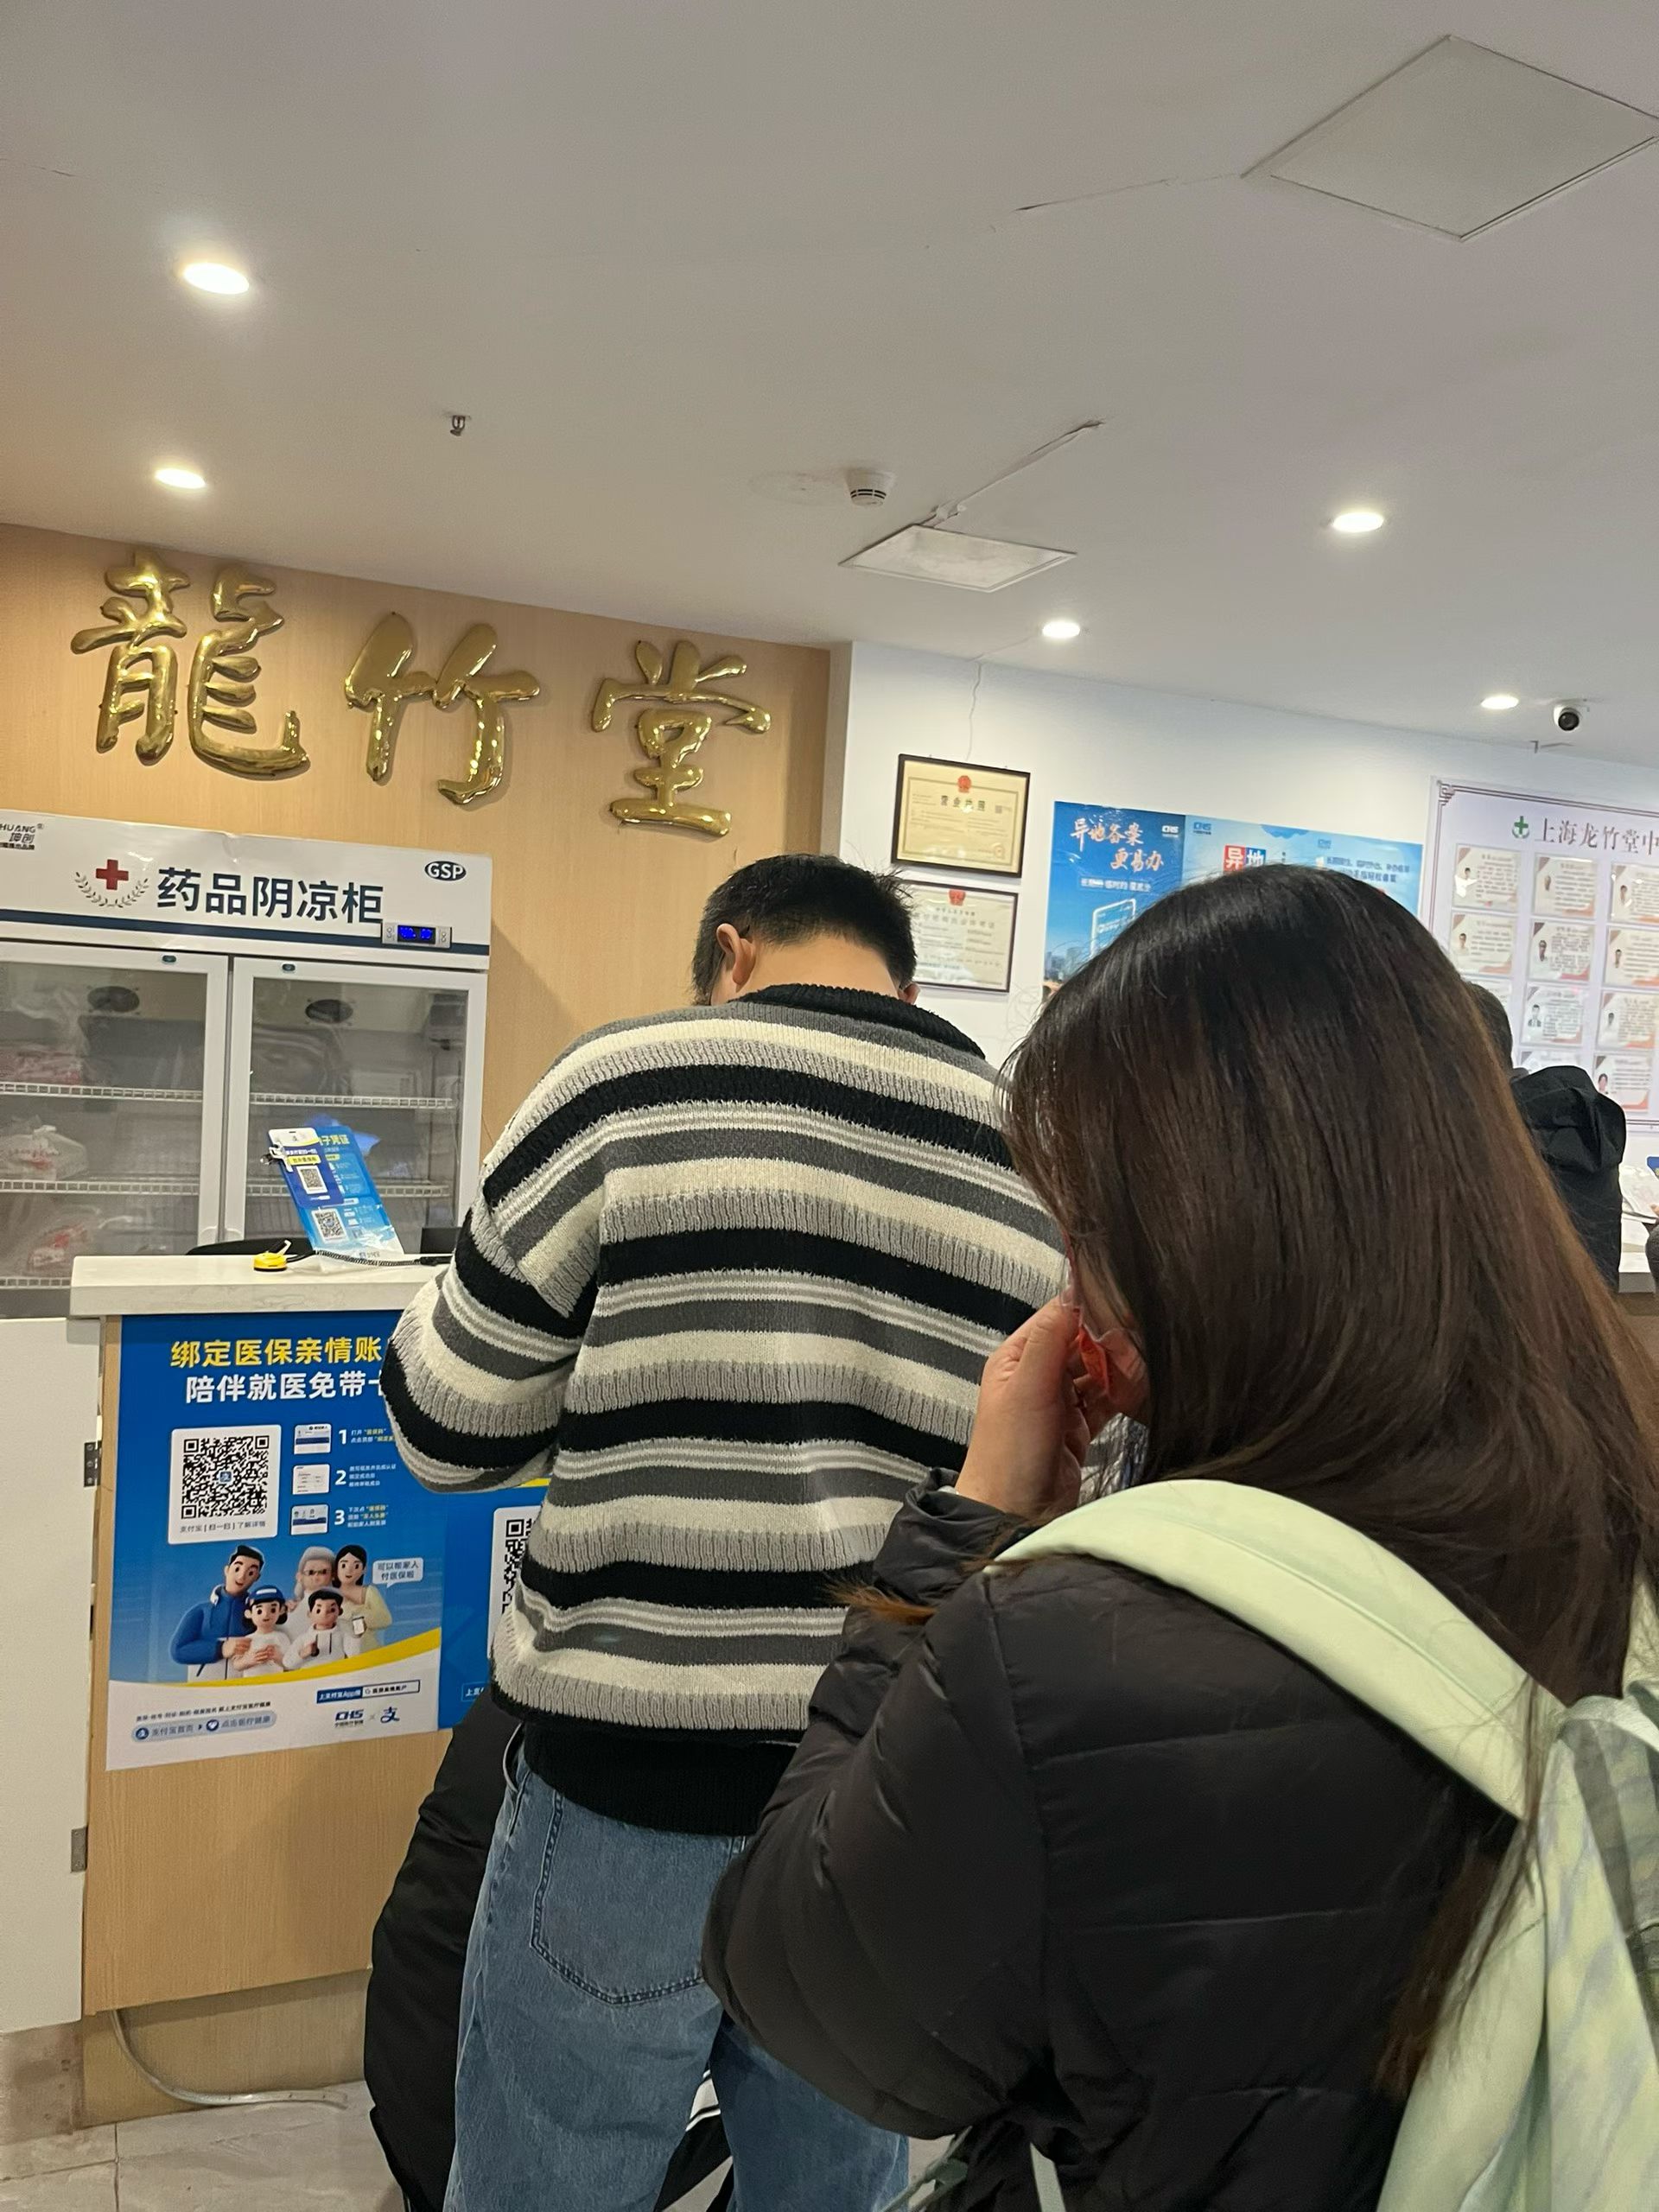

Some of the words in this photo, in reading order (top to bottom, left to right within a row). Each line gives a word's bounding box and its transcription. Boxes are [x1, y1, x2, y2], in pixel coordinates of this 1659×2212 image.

[71, 553, 772, 838] 龍竹堂
[1070, 817, 1144, 852] 异地备案
[427, 862, 464, 880] GSP
[1110, 847, 1164, 873] 更易办
[1226, 847, 1265, 872] 异地
[157, 867, 384, 924] 药品阴凉柜
[318, 1135, 350, 1146] 子凭证
[170, 1336, 383, 1369] 绑定医保亲情账
[338, 1429, 347, 1446] 1
[334, 1470, 347, 1486] 2
[334, 1509, 346, 1526] 3
